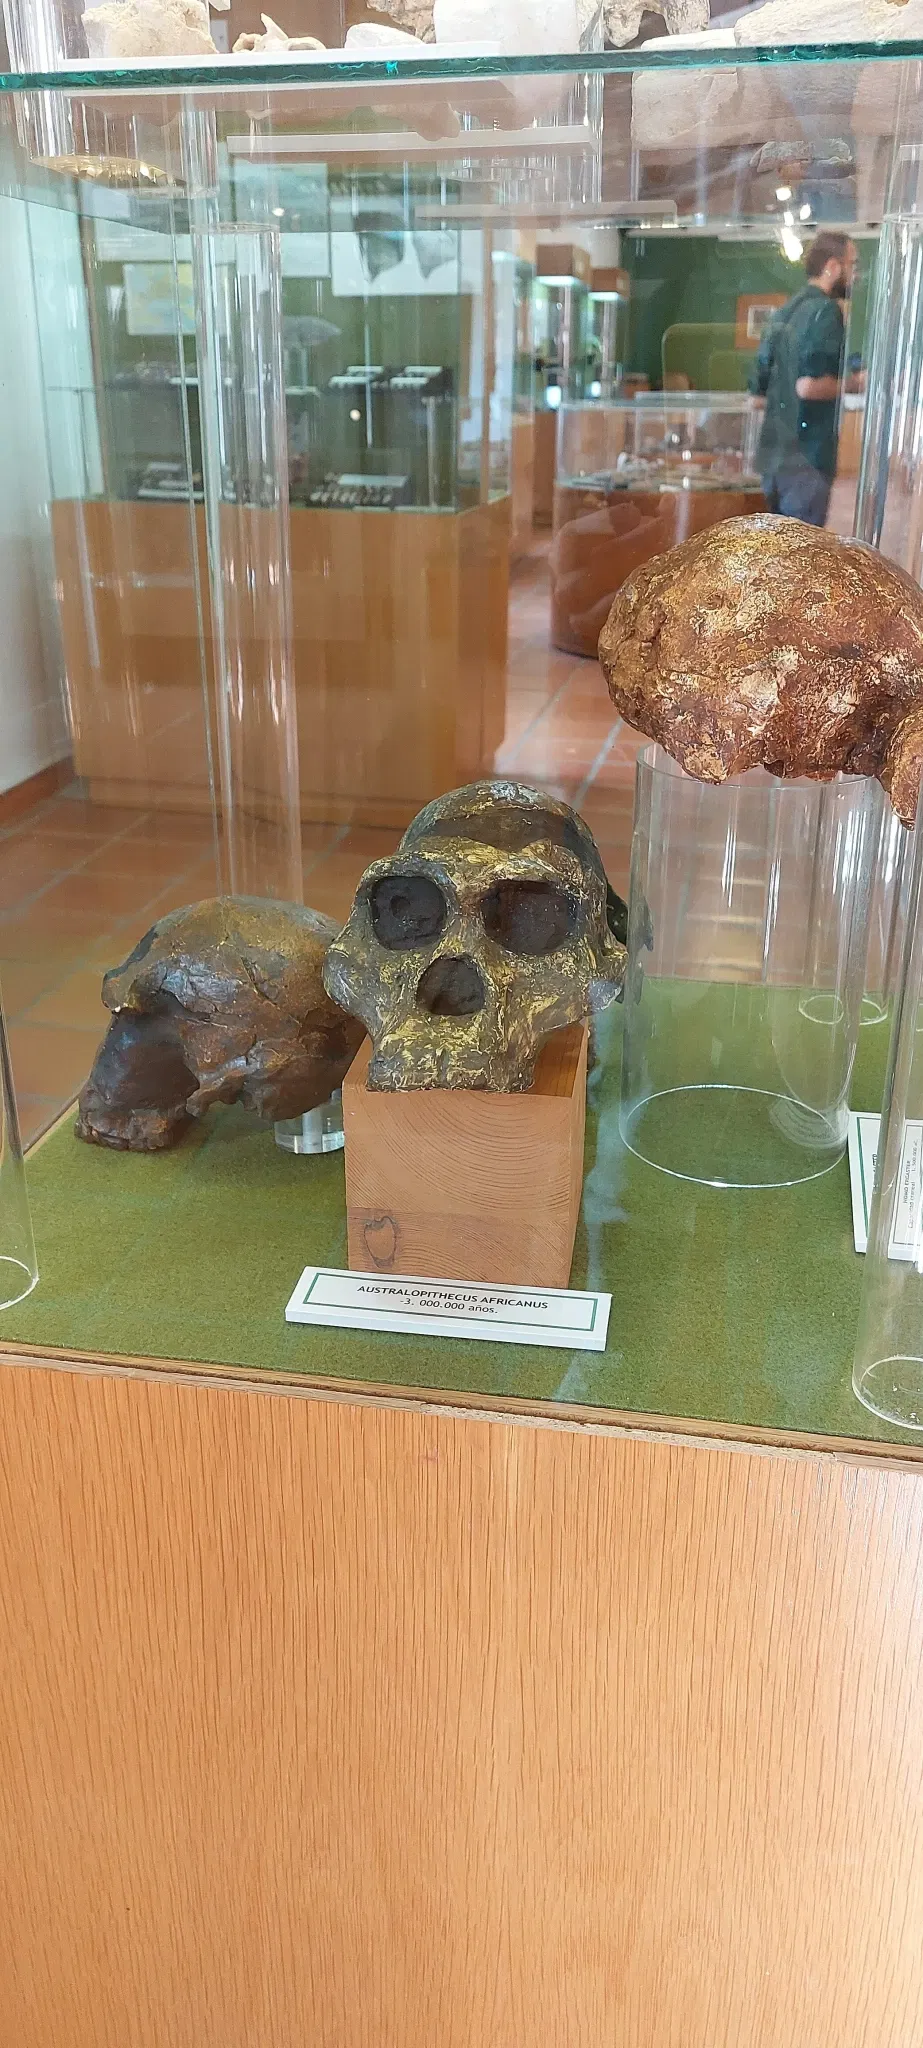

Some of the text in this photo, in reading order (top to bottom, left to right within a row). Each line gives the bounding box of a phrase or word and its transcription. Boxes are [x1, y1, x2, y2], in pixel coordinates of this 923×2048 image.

[357, 1285, 549, 1309] AUSTRALOPITHECUS AFRICANUS
[419, 1299, 465, 1310] 000.000
[468, 1303, 499, 1314] años.
